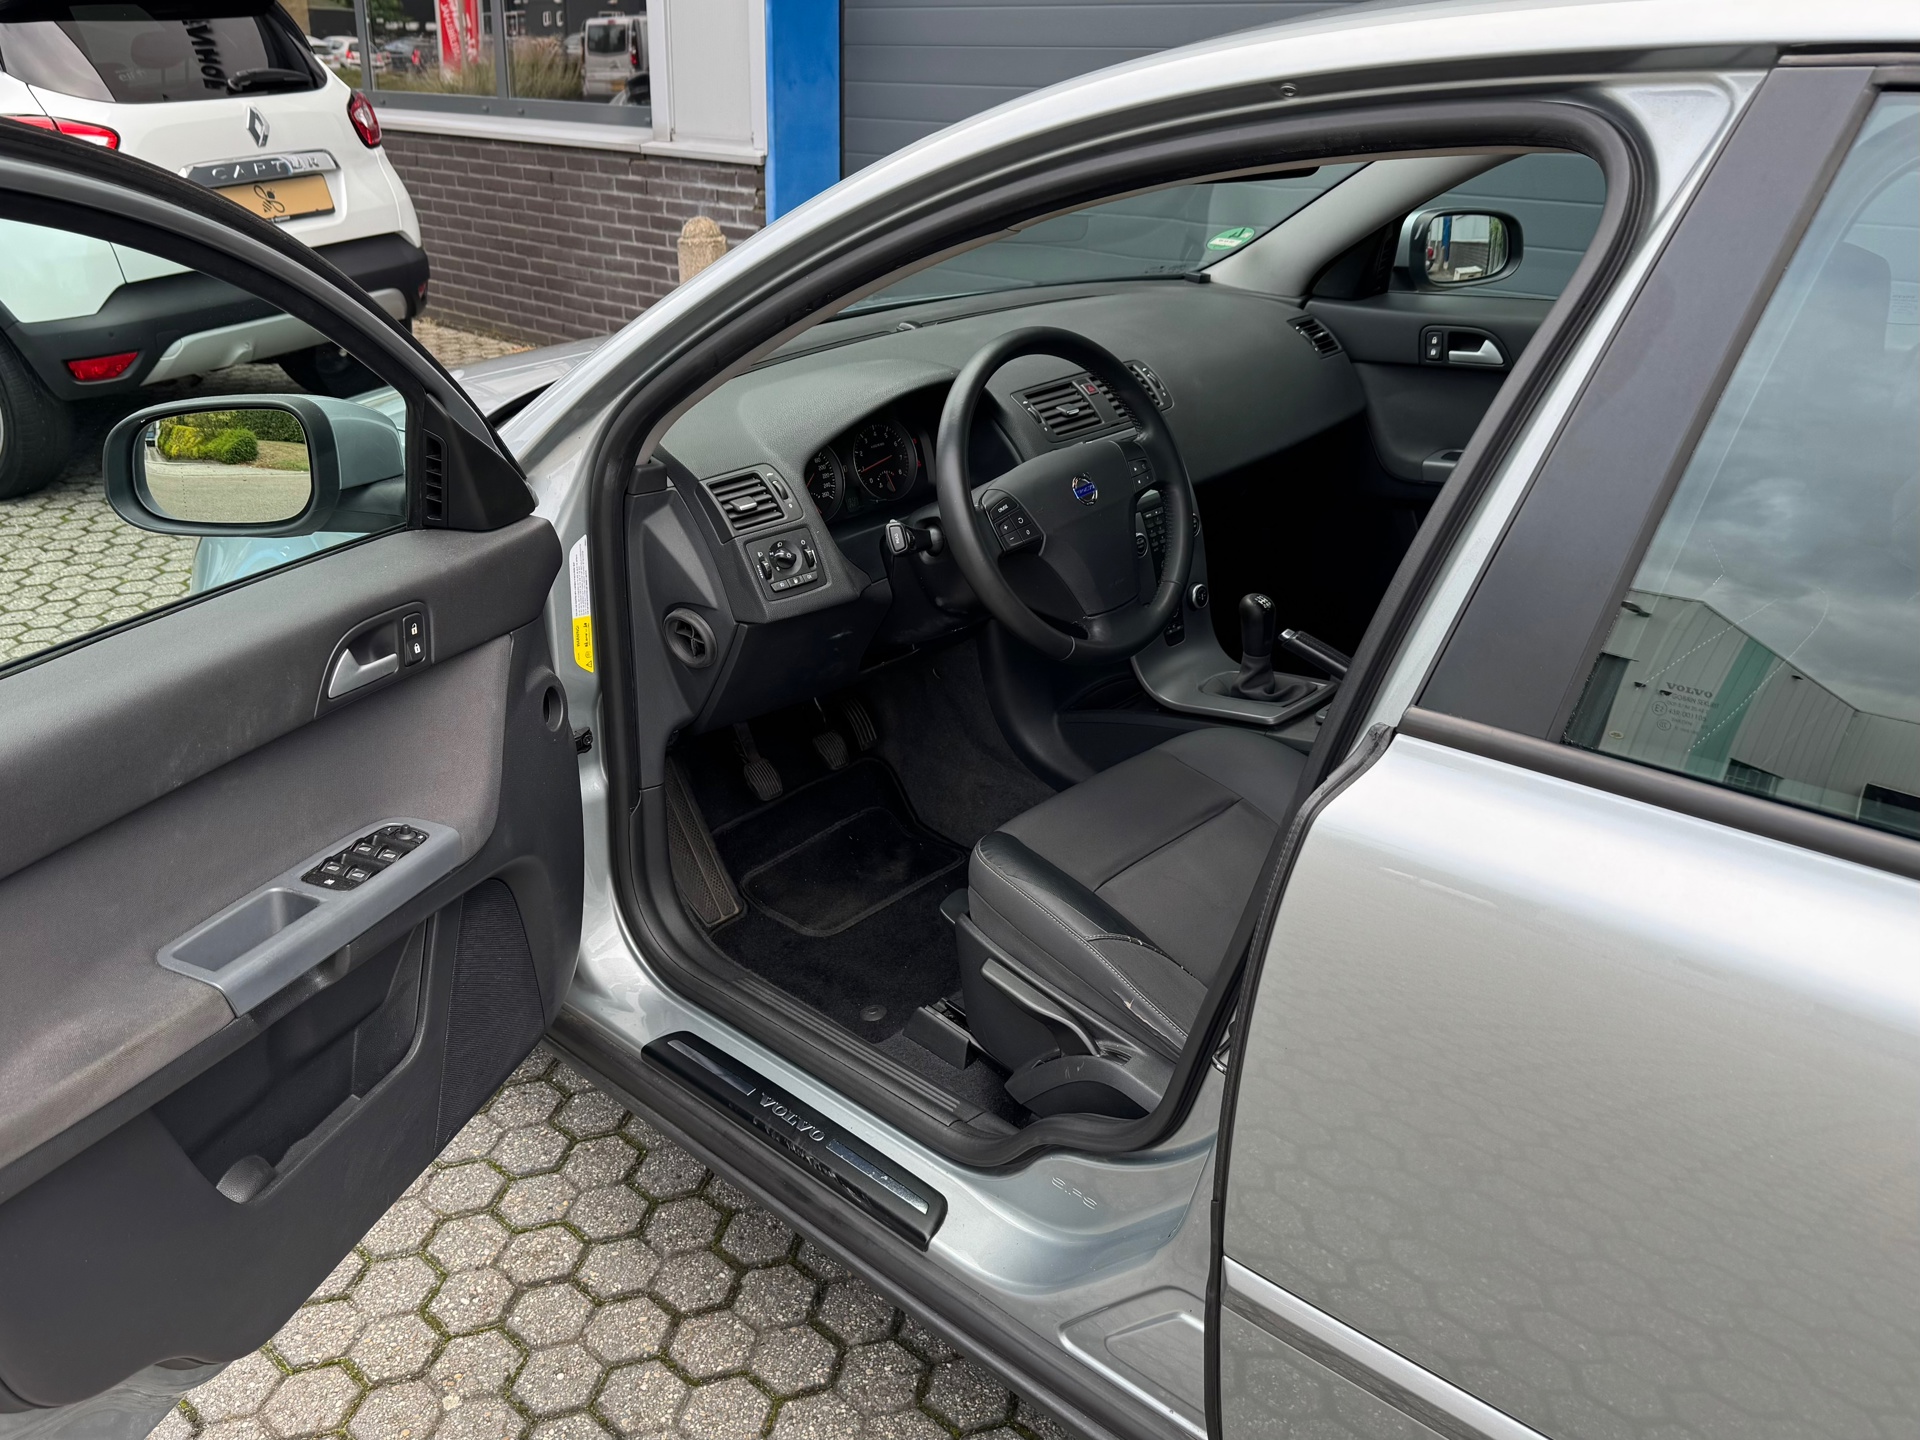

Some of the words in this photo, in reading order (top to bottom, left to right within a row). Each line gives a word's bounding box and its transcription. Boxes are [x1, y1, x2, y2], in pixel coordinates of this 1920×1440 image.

[211, 157, 320, 180] CAPTUR
[1666, 682, 1713, 698] VOLVO
[760, 1092, 826, 1142] VOLVO
